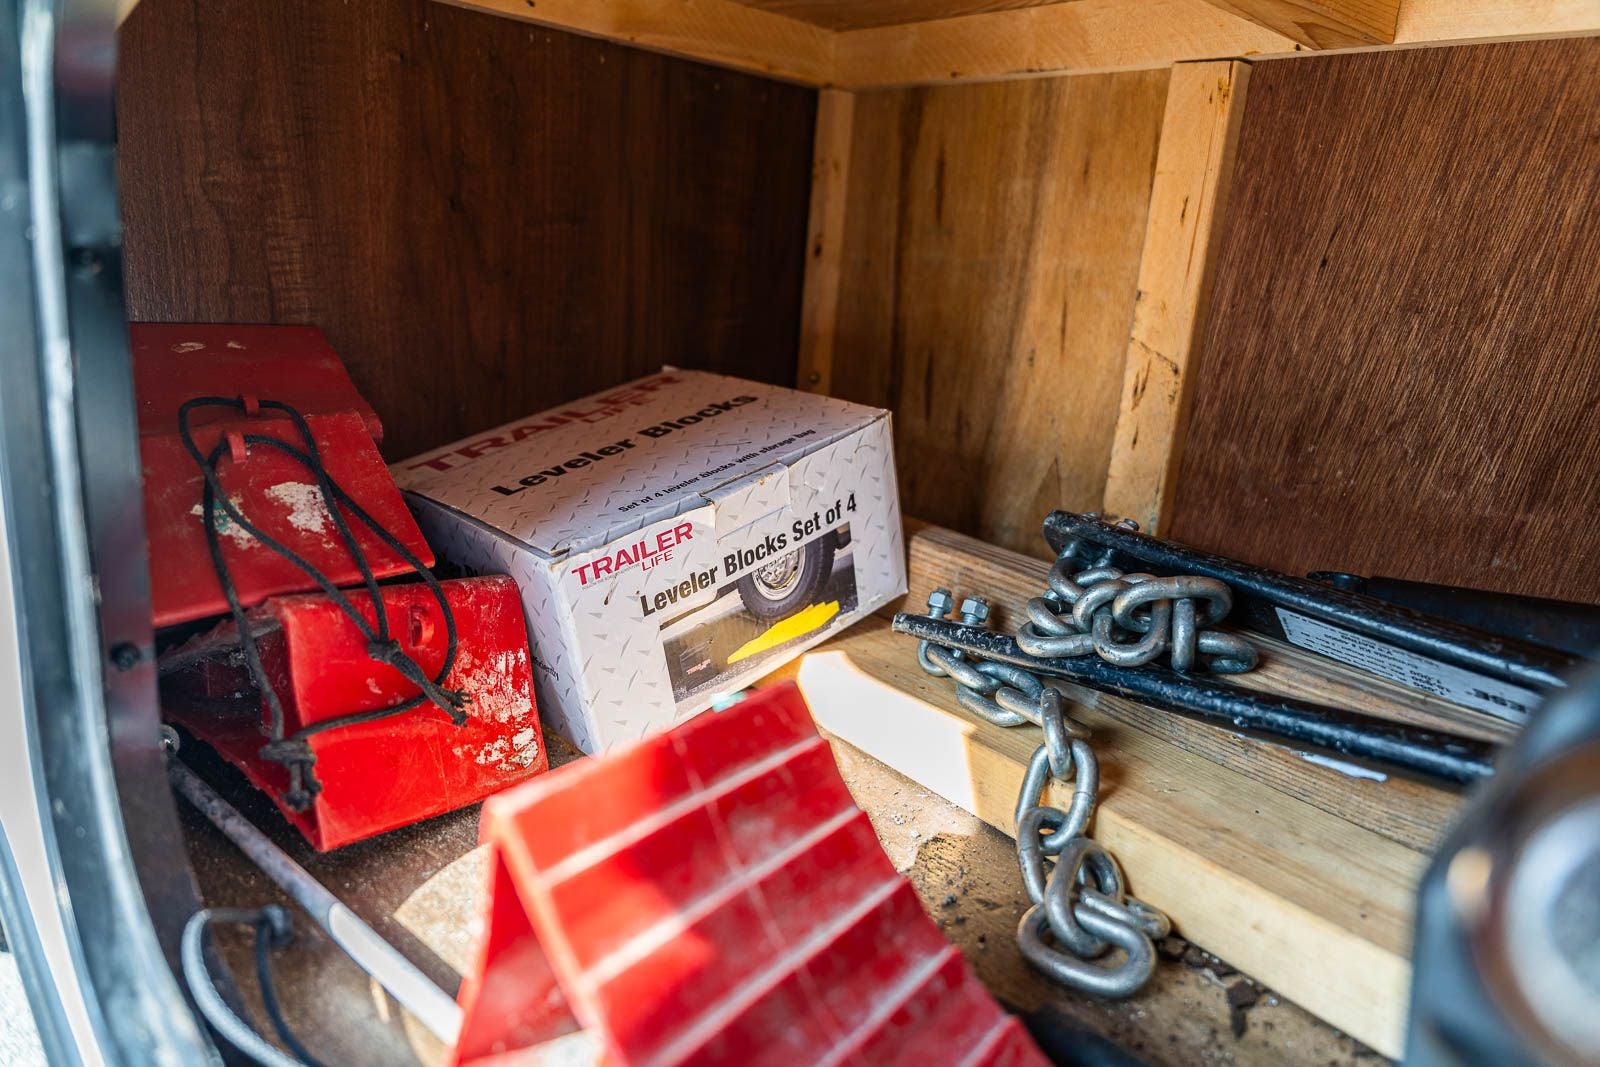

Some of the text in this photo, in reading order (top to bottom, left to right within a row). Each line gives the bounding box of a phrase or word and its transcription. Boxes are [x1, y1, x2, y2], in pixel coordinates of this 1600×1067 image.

[406, 375, 682, 472] TRAILER
[490, 395, 759, 496] Leveler Blocks
[618, 428, 817, 513] Set of 4 leveler blocks with storage bag
[571, 521, 694, 586] TRAILER
[640, 564, 719, 617] Leveler
[723, 530, 788, 577] Blocks
[792, 514, 821, 542] Set
[825, 500, 842, 524] of
[846, 493, 858, 513] 4
[642, 549, 674, 572] LIFE
